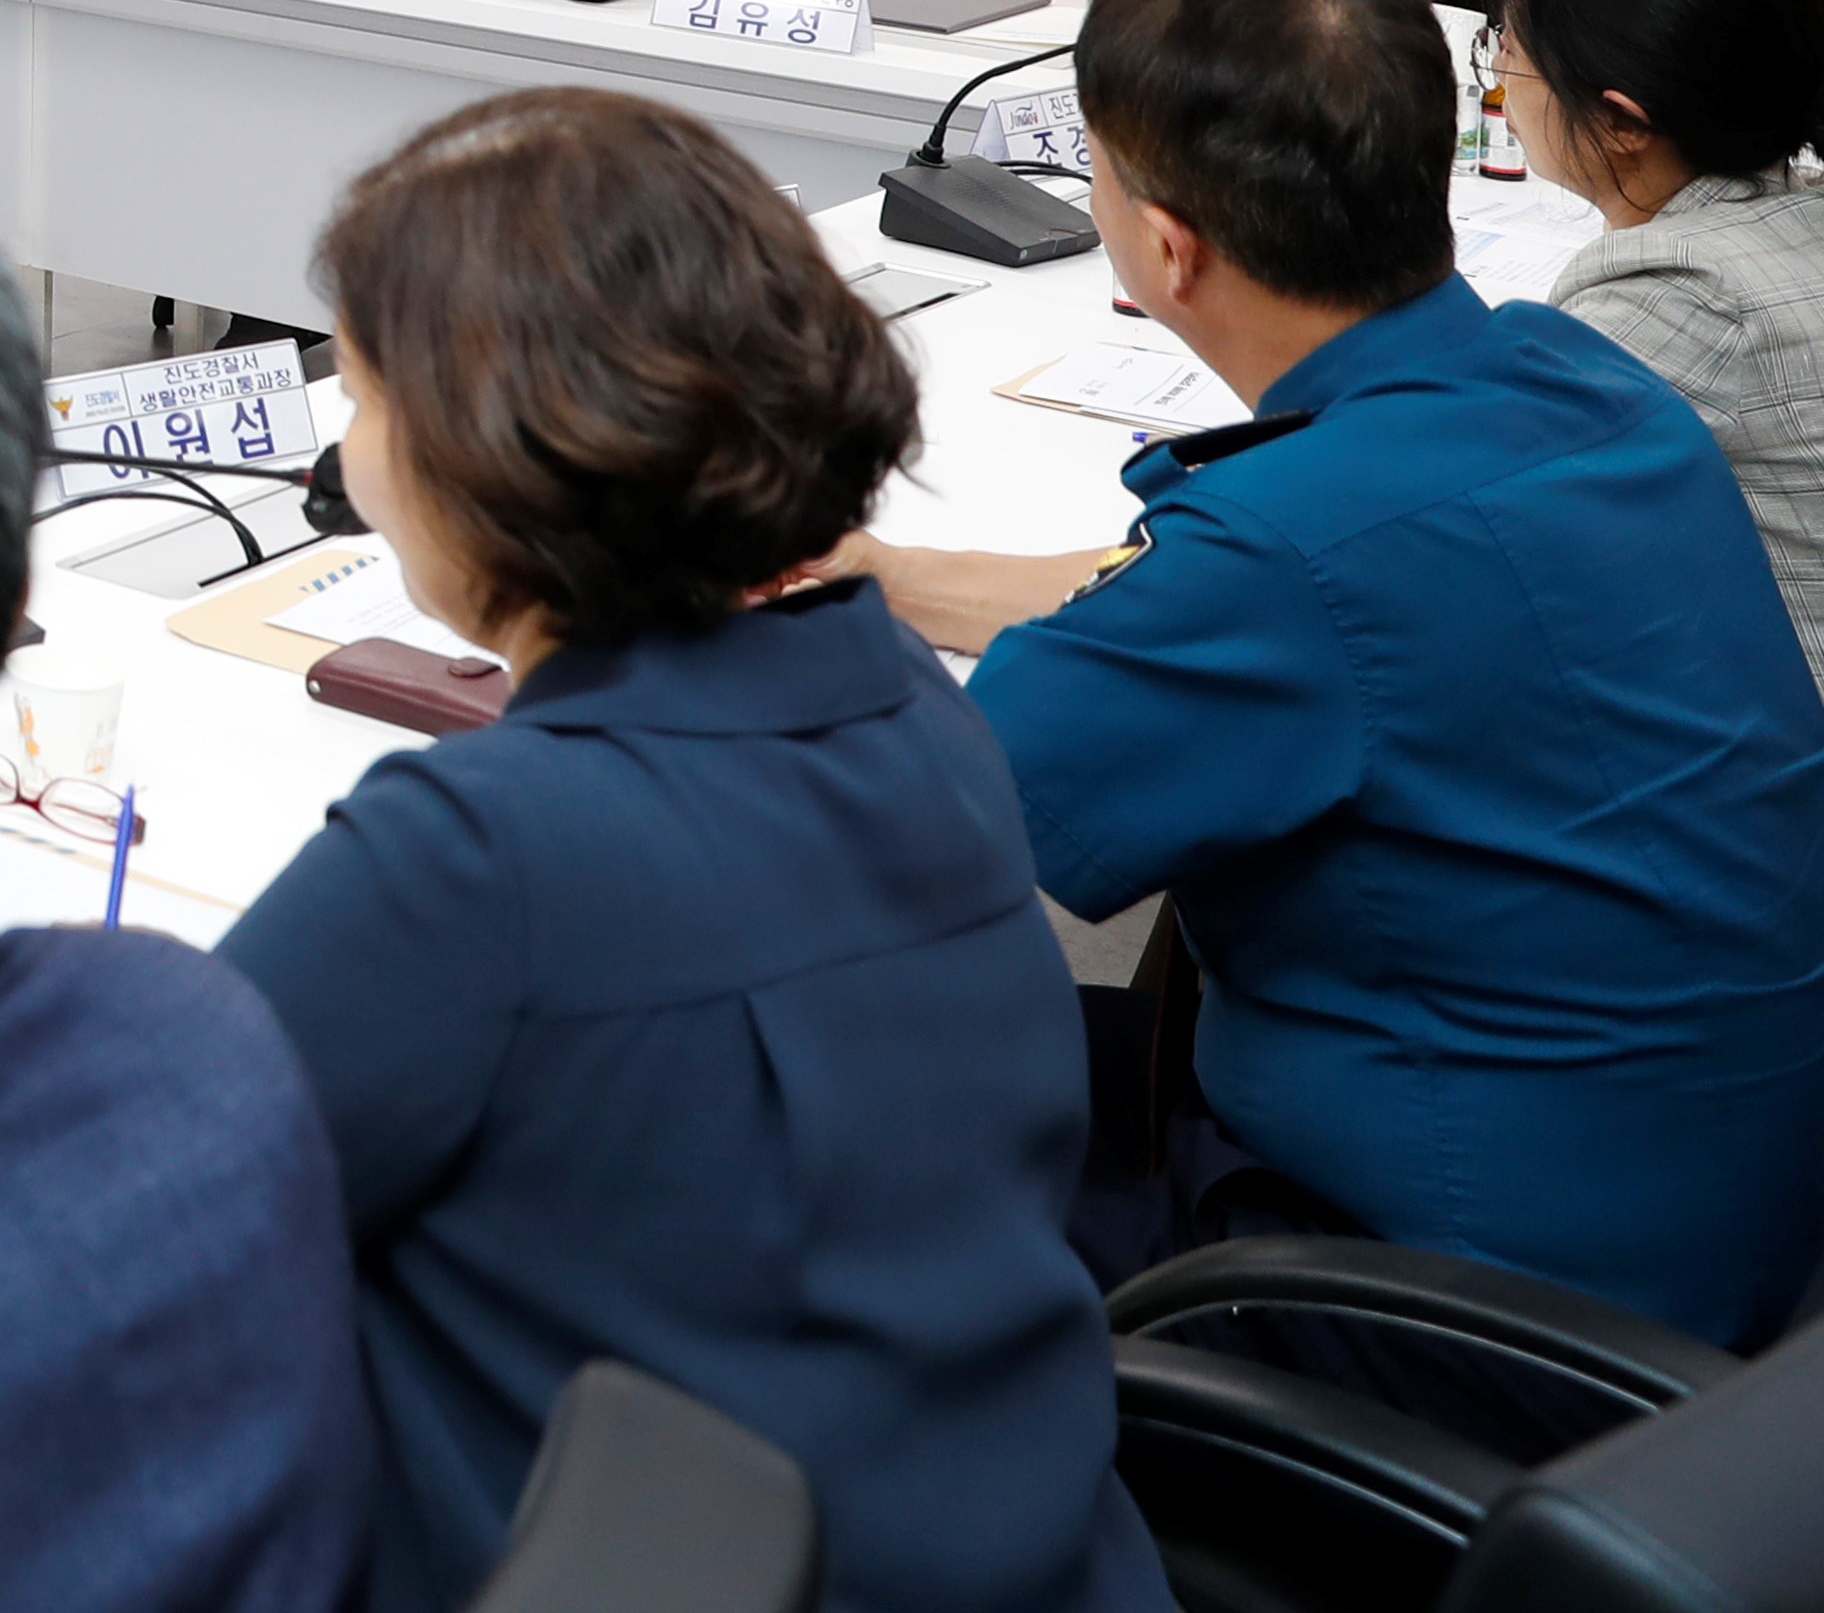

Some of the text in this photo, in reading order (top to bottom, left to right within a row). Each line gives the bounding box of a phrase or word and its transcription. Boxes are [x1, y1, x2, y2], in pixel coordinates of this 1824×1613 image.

[1050, 94, 1082, 120] 진도
[164, 352, 261, 385] 진도경찰서
[139, 368, 292, 413] 생활안전교통과장
[103, 397, 276, 480] 이원섭
